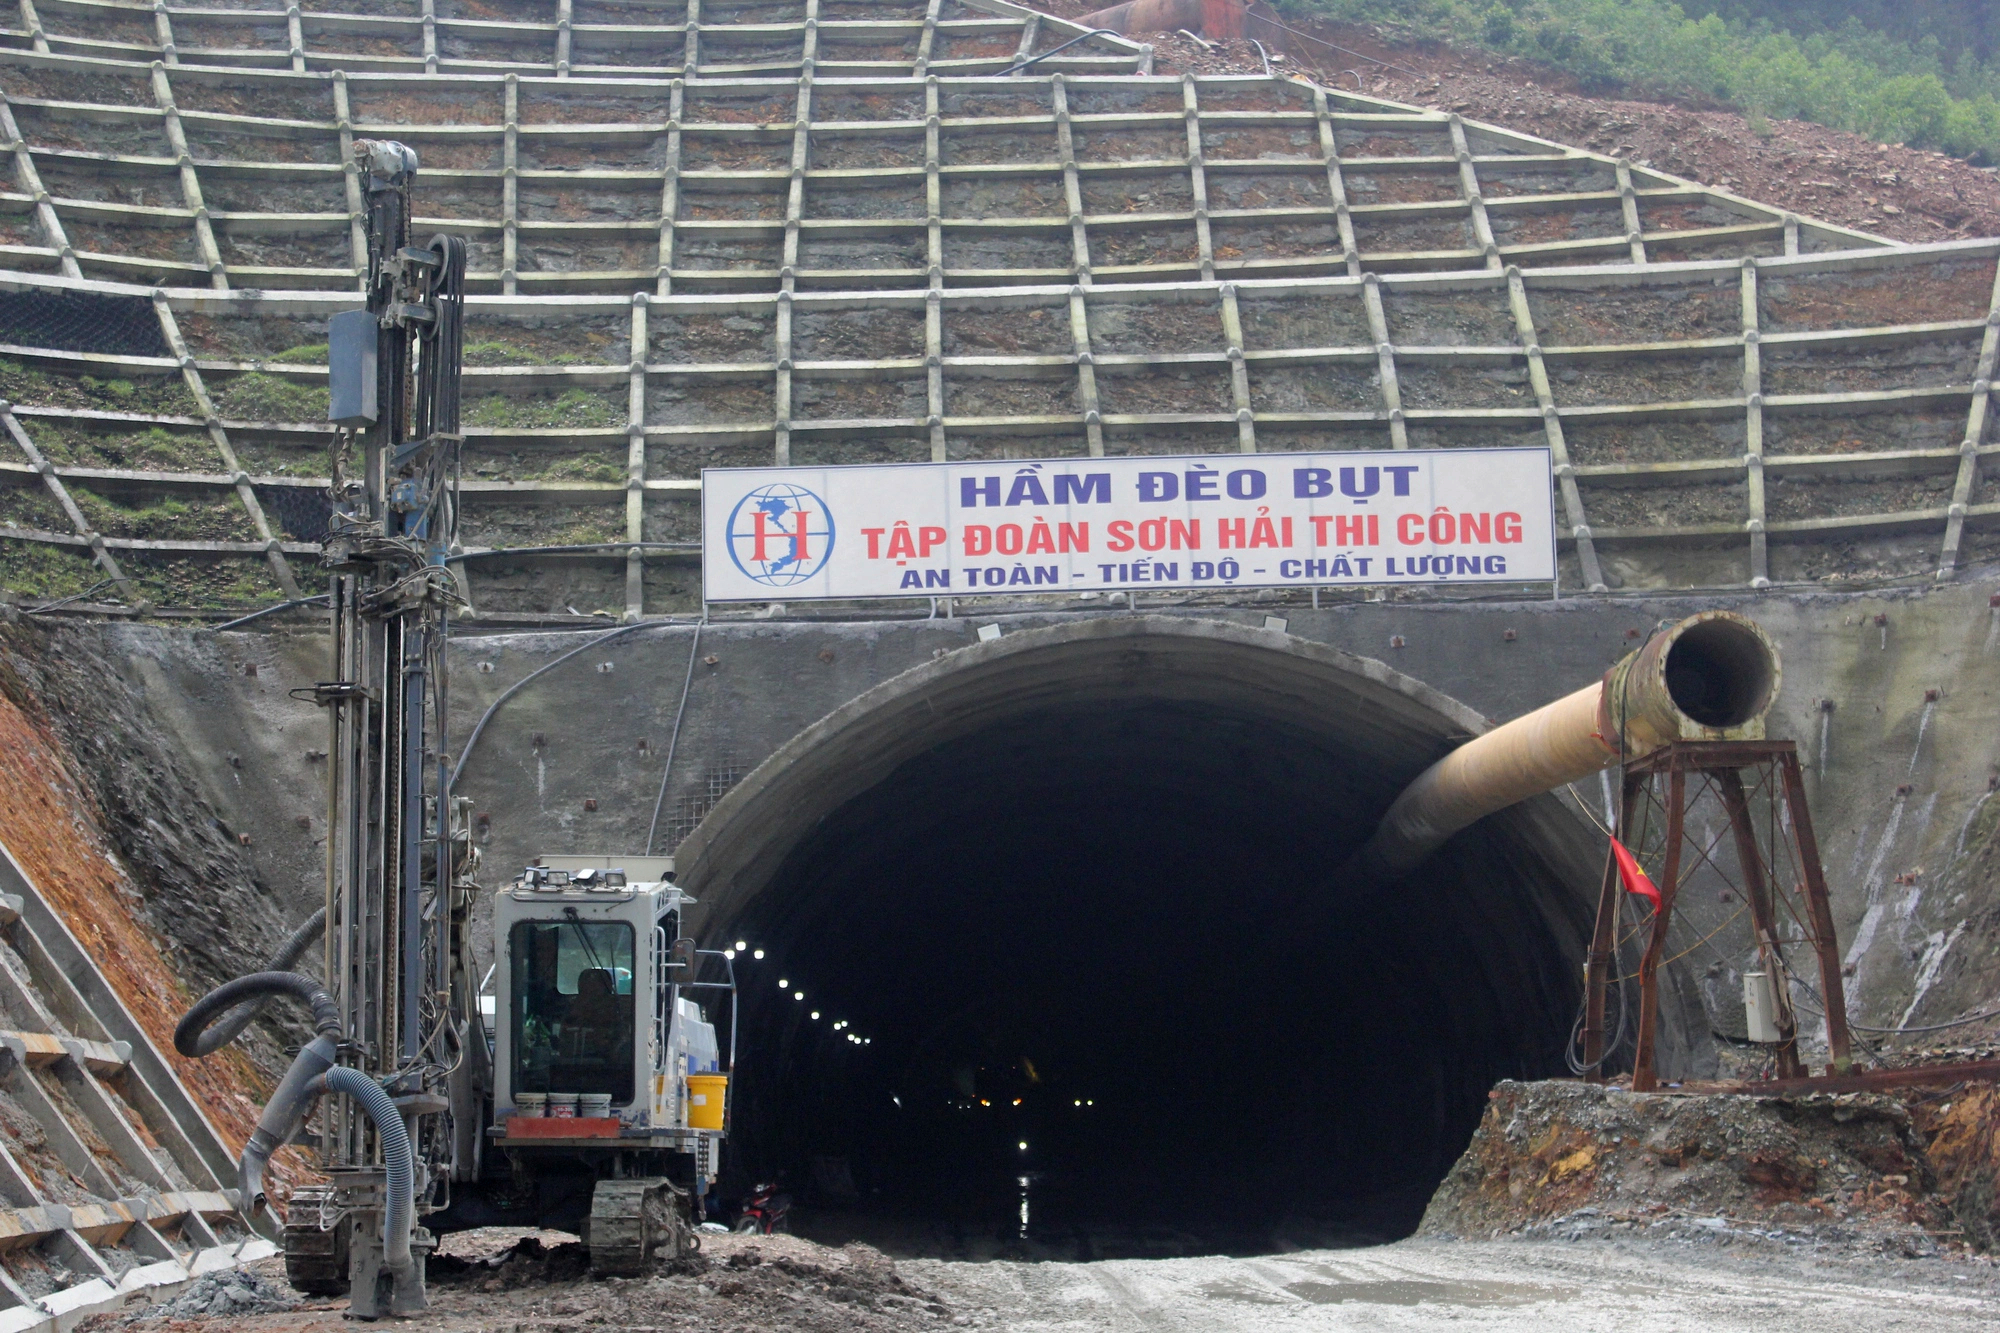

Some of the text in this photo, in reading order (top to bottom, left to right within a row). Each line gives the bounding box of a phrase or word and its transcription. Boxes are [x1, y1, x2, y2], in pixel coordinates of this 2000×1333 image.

[960, 463, 1420, 508] HẦM ĐÈO BỤT
[861, 506, 1524, 566] TẬP ĐOÀN SƠN HẢI THI CÔNG
[900, 568, 951, 589] AN
[963, 562, 1060, 587] TOÀN
[1097, 556, 1180, 583] TIẾN
[1190, 557, 1241, 584] ĐỘ
[1279, 551, 1374, 579] CHẤT
[1386, 554, 1507, 579] LƯỢNG
